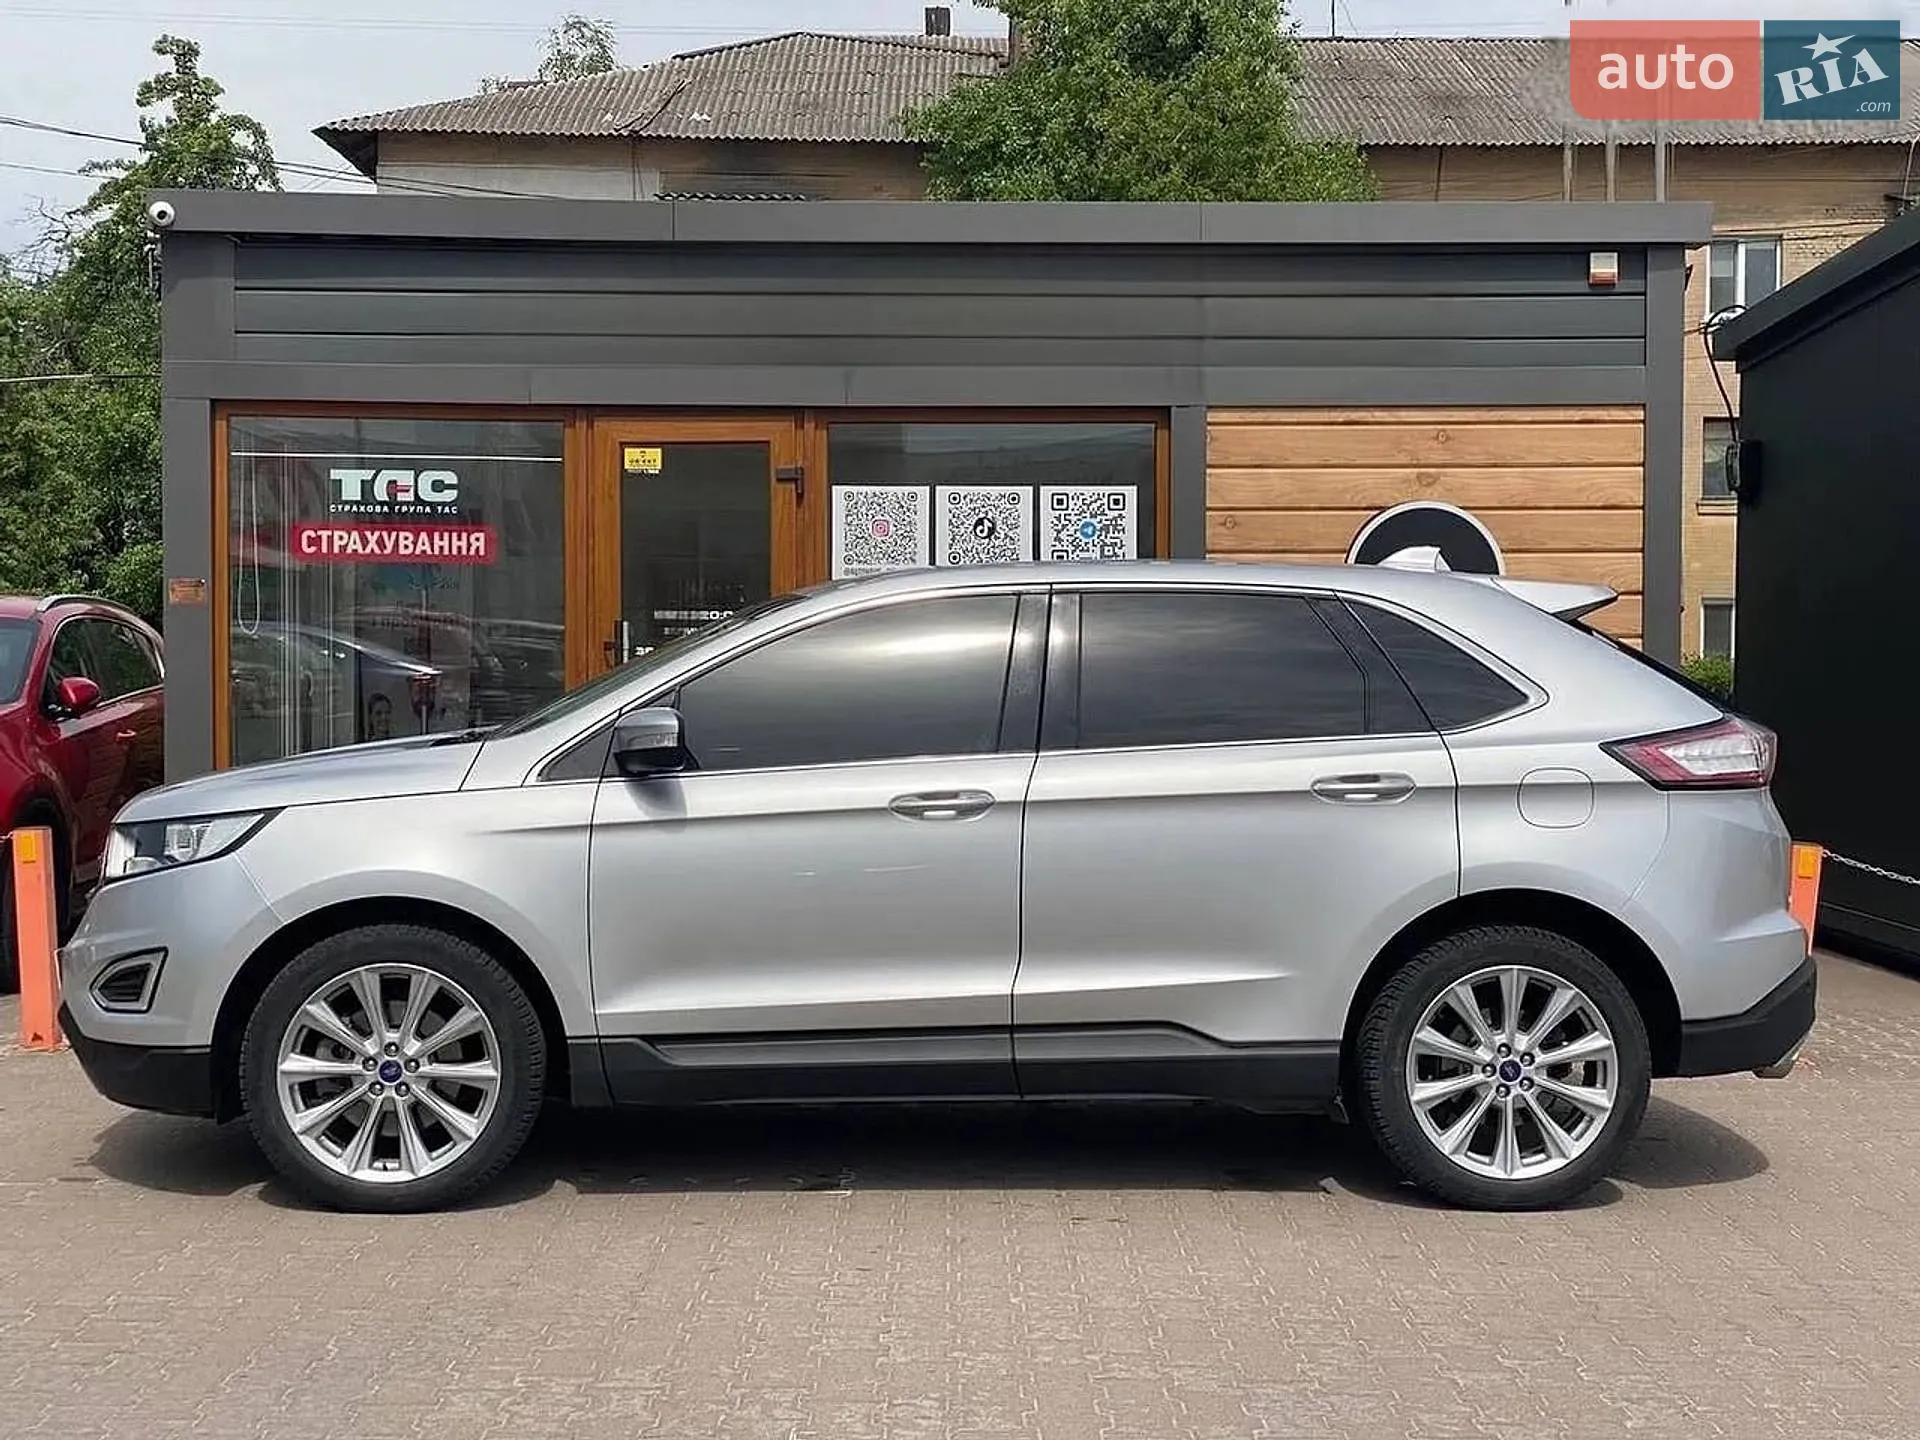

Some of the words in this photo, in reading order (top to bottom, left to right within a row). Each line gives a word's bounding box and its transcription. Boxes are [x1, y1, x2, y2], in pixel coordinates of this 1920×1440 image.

[329, 503, 389, 514] СТРАХОВА
[394, 505, 431, 514] ГРУПА
[437, 506, 458, 514] ТАС
[301, 529, 486, 556] СТРАХУВАННЯ
